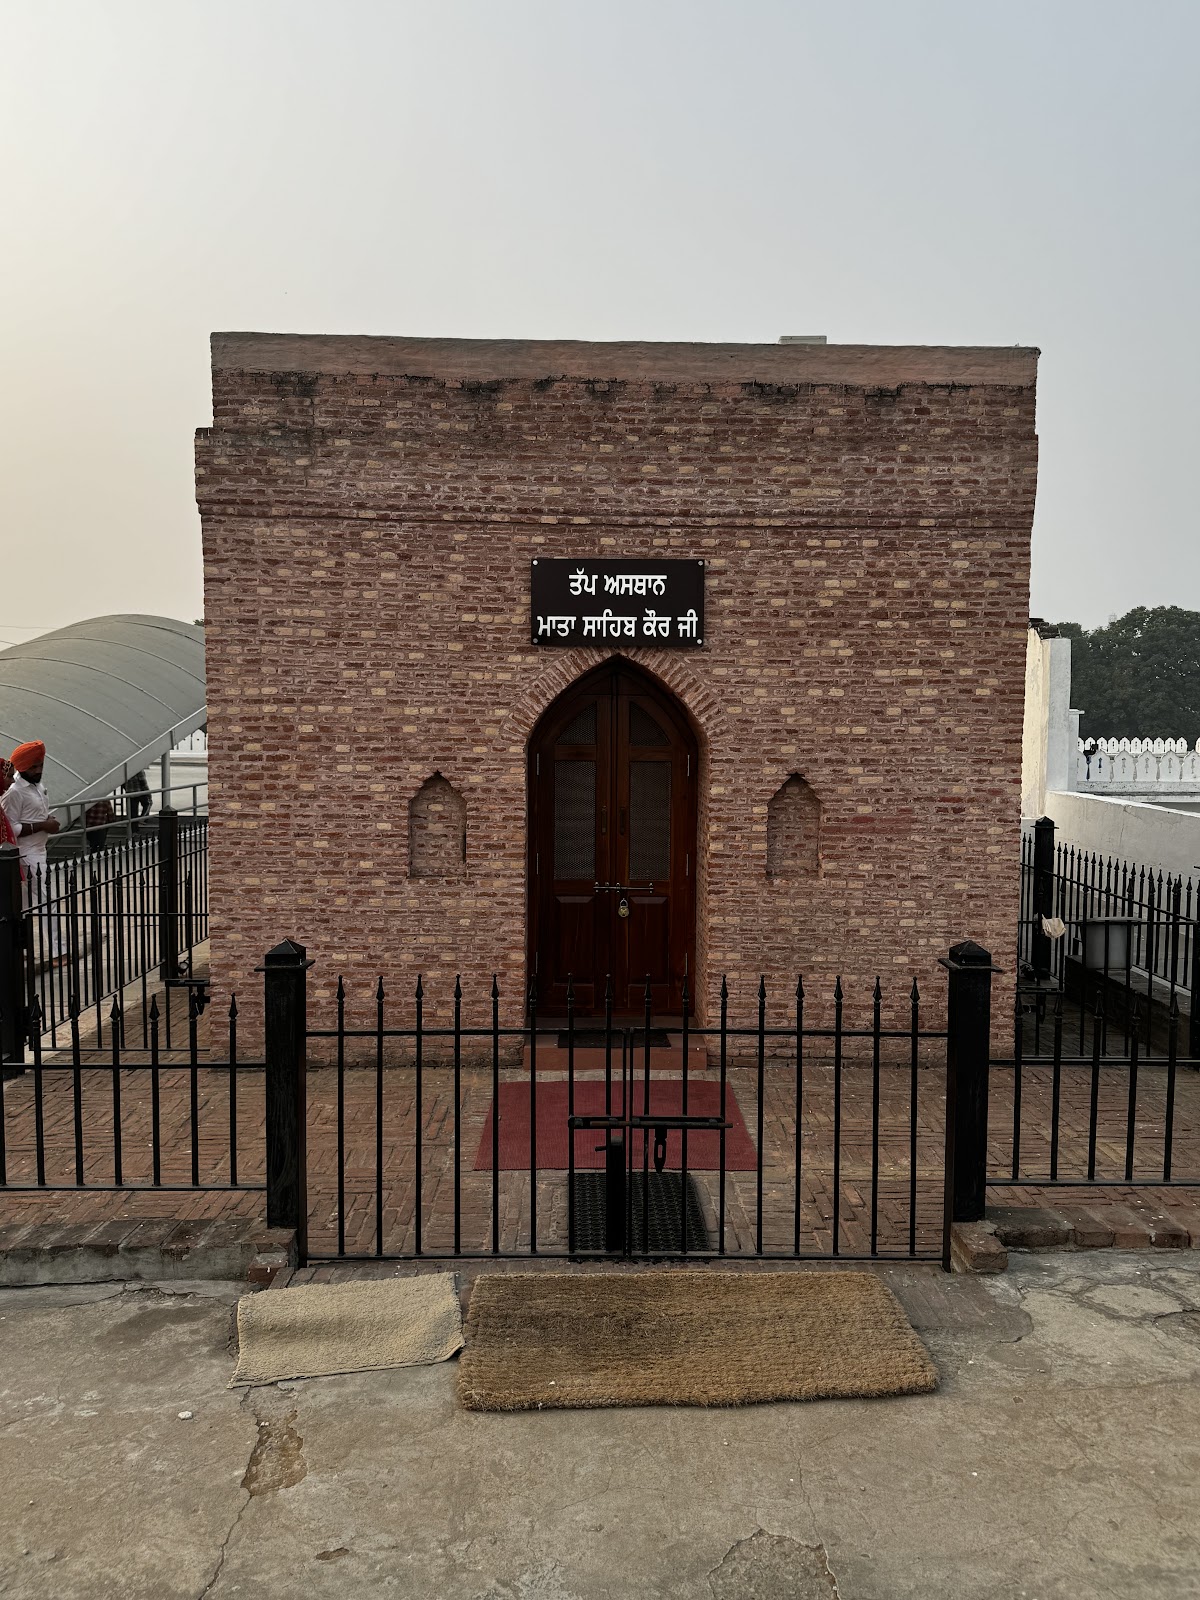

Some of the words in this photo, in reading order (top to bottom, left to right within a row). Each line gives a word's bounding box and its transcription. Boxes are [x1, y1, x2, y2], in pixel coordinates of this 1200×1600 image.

[569, 568, 598, 595] ਤੱਪ
[604, 575, 667, 595] ਅਸਥਾਨ
[537, 616, 576, 637] ਮਾਤਾ
[582, 609, 637, 637] ਸਾਹਿਬ
[643, 608, 671, 637] ਕੌਰ
[677, 609, 698, 637] ਜੀ
